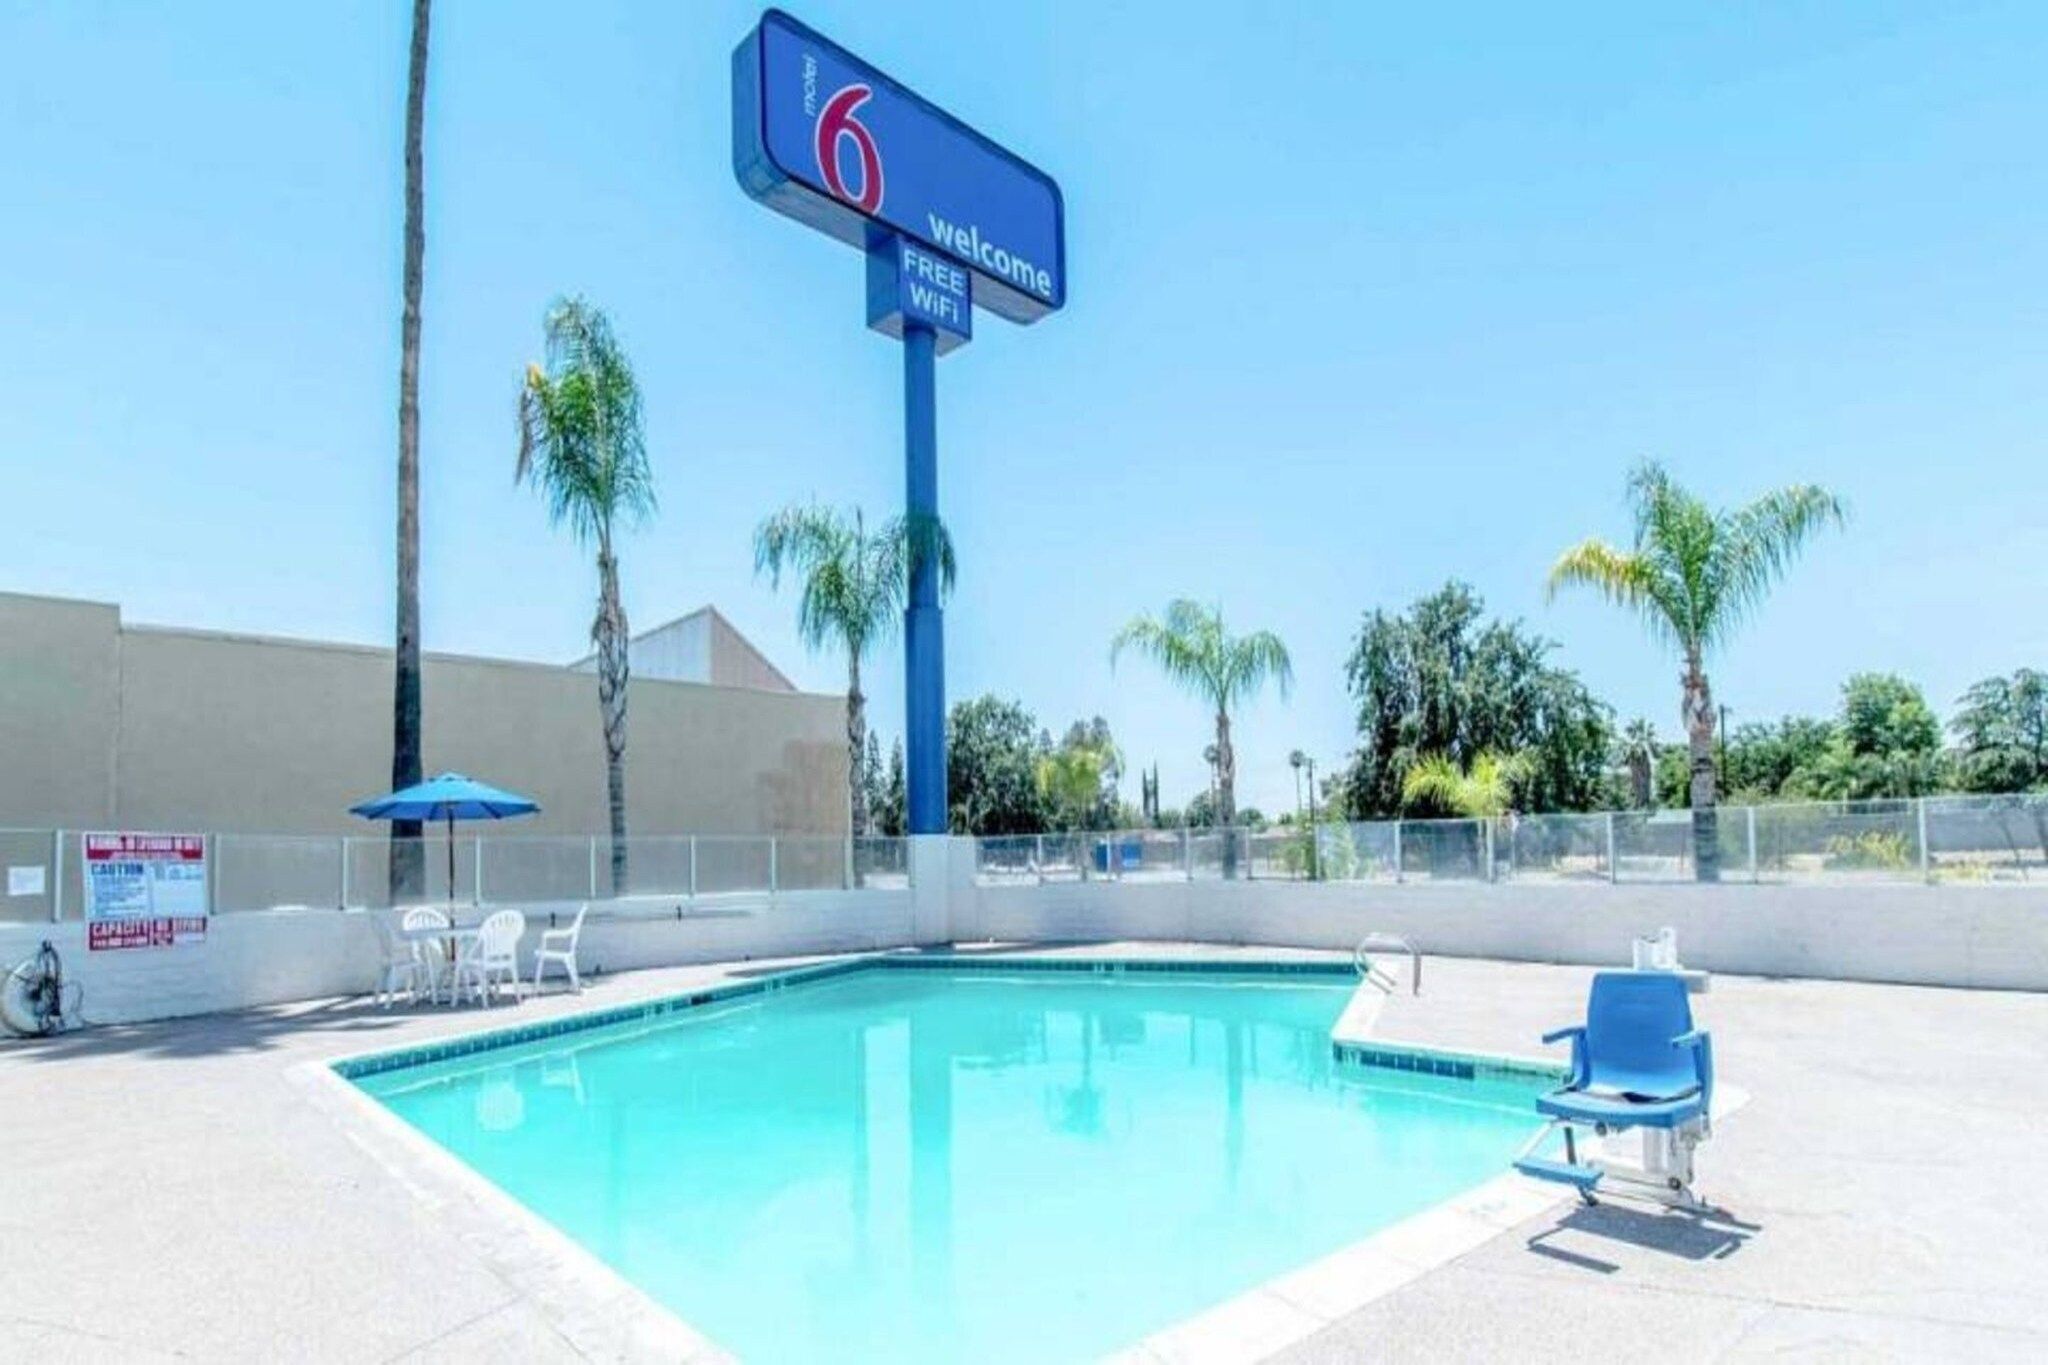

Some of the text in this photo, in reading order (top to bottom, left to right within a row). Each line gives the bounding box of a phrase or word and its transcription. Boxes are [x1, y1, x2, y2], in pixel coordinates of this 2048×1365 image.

[803, 54, 818, 117] motel
[815, 83, 883, 216] 6
[904, 250, 963, 297] FREE
[929, 214, 1052, 297] welcome
[910, 283, 958, 323] WiFi
[91, 863, 144, 876] CAUTION
